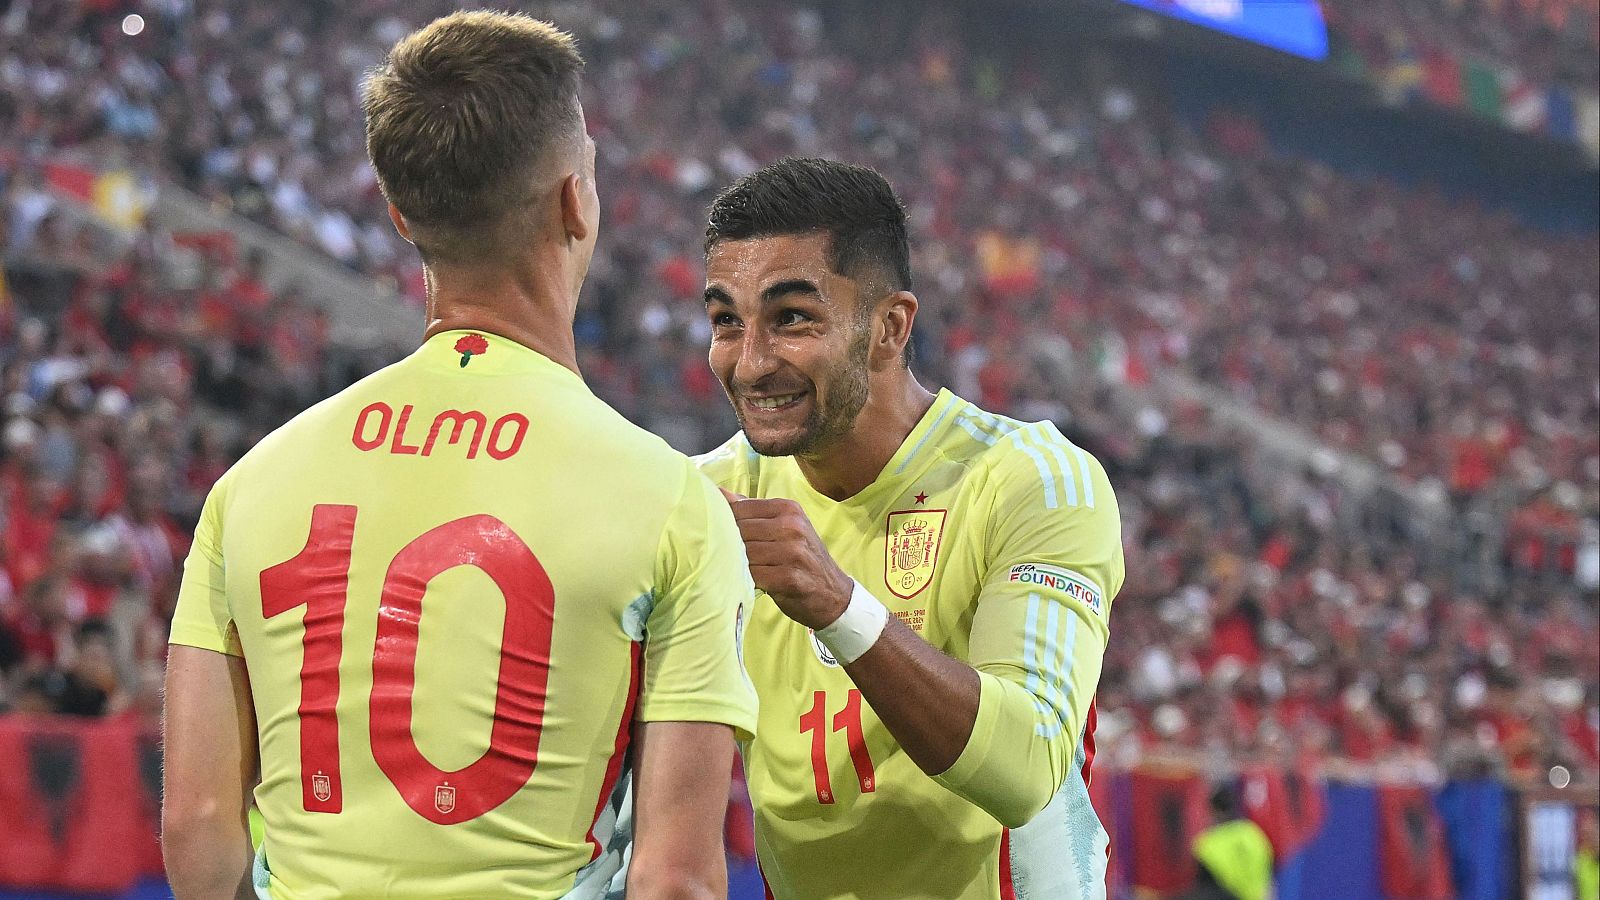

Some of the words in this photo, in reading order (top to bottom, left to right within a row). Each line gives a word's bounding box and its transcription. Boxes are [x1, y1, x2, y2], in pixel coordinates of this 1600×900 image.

[352, 401, 530, 460] OLMO
[1011, 564, 1036, 573] UEFA
[259, 503, 555, 825] 10
[800, 689, 875, 804] 11
